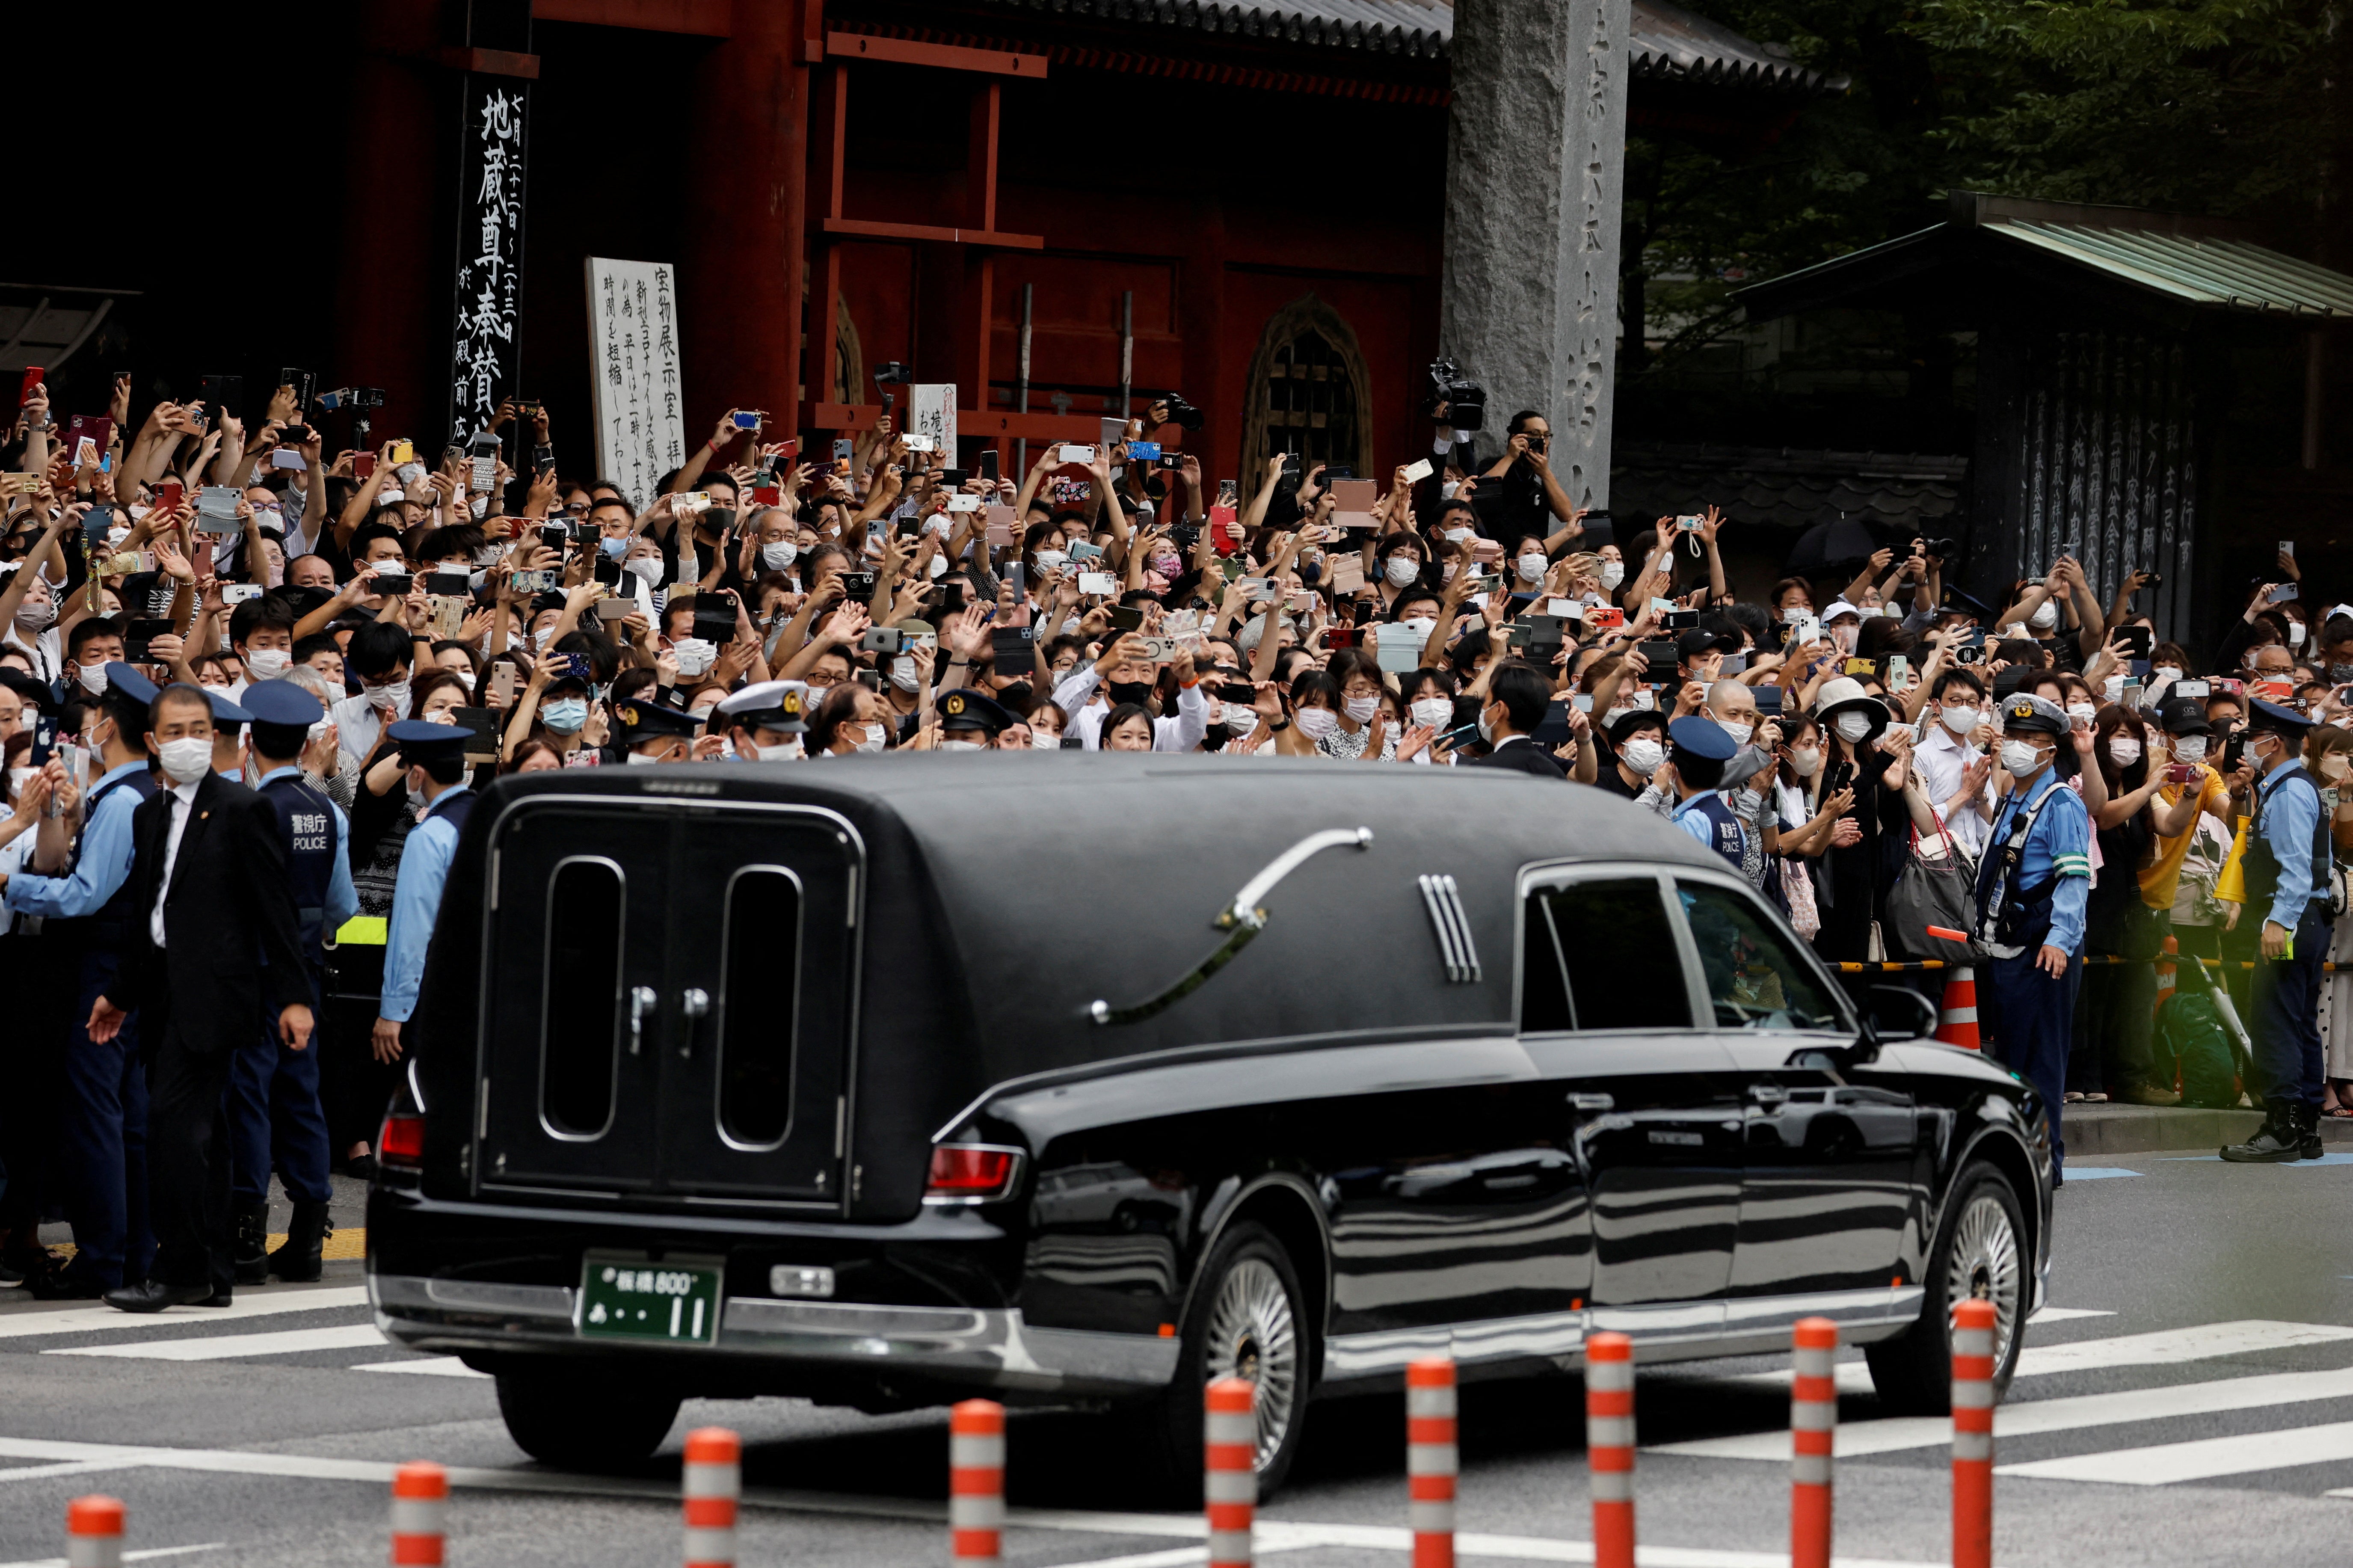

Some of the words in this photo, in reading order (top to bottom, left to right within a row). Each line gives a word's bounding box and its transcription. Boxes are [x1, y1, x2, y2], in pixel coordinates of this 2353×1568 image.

[452, 265, 472, 454] 於大殿前広
[655, 266, 681, 472] 宝物展示室〜拝
[603, 273, 624, 492] 時間を短縮しており
[291, 813, 328, 834] 警視庁
[1719, 822, 1738, 839] 警視庁
[293, 836, 327, 850] POLICE
[1722, 841, 1740, 853] POLICE
